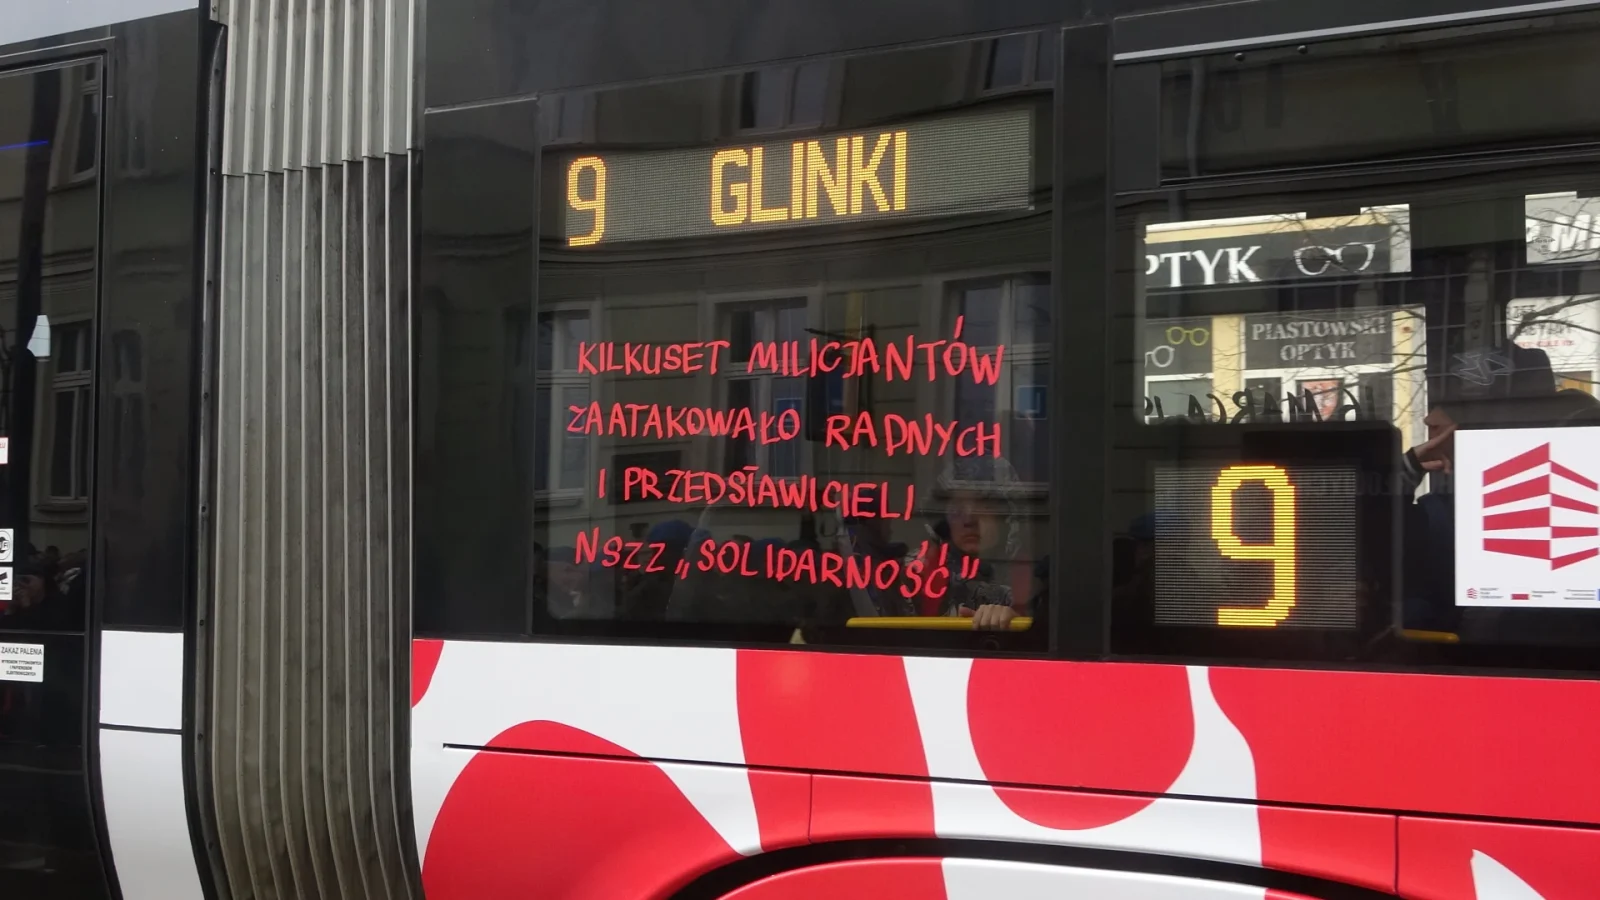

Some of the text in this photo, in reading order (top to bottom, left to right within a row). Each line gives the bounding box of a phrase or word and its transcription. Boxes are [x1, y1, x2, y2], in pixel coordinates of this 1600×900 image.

[566, 131, 908, 247] 9 GLINKI
[577, 315, 1005, 386] KILKUSET MILICJANTÓW
[1251, 317, 1387, 341] PIASTOWSKI
[1280, 341, 1357, 361] OPTYK
[567, 401, 1002, 459] ZAATAKOWAŁO RADNYCH
[598, 465, 915, 521] I PRZEDSTAWICIELI
[575, 527, 667, 573] NSZZ
[1211, 465, 1296, 627] 9
[1, 646, 43, 656] ZAKAZ PALENIA
